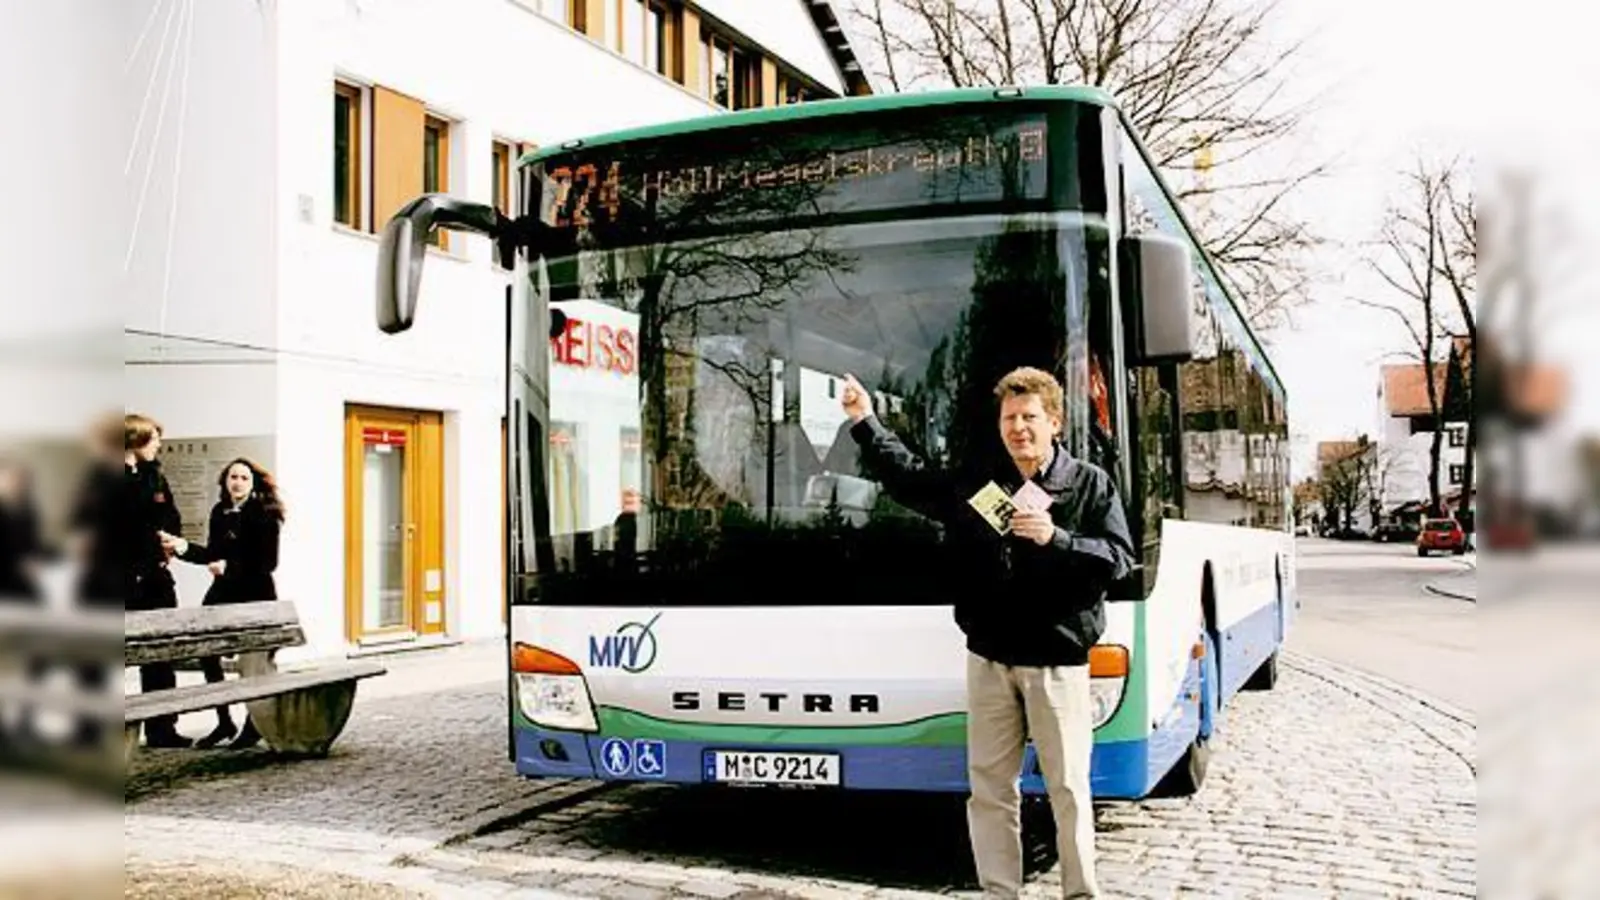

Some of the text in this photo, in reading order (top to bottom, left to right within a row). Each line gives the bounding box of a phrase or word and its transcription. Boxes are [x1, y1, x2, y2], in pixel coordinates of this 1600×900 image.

[551, 162, 620, 226] 224
[590, 614, 660, 668] MVV
[672, 692, 879, 712] SETRA
[773, 757, 828, 780] 9214
